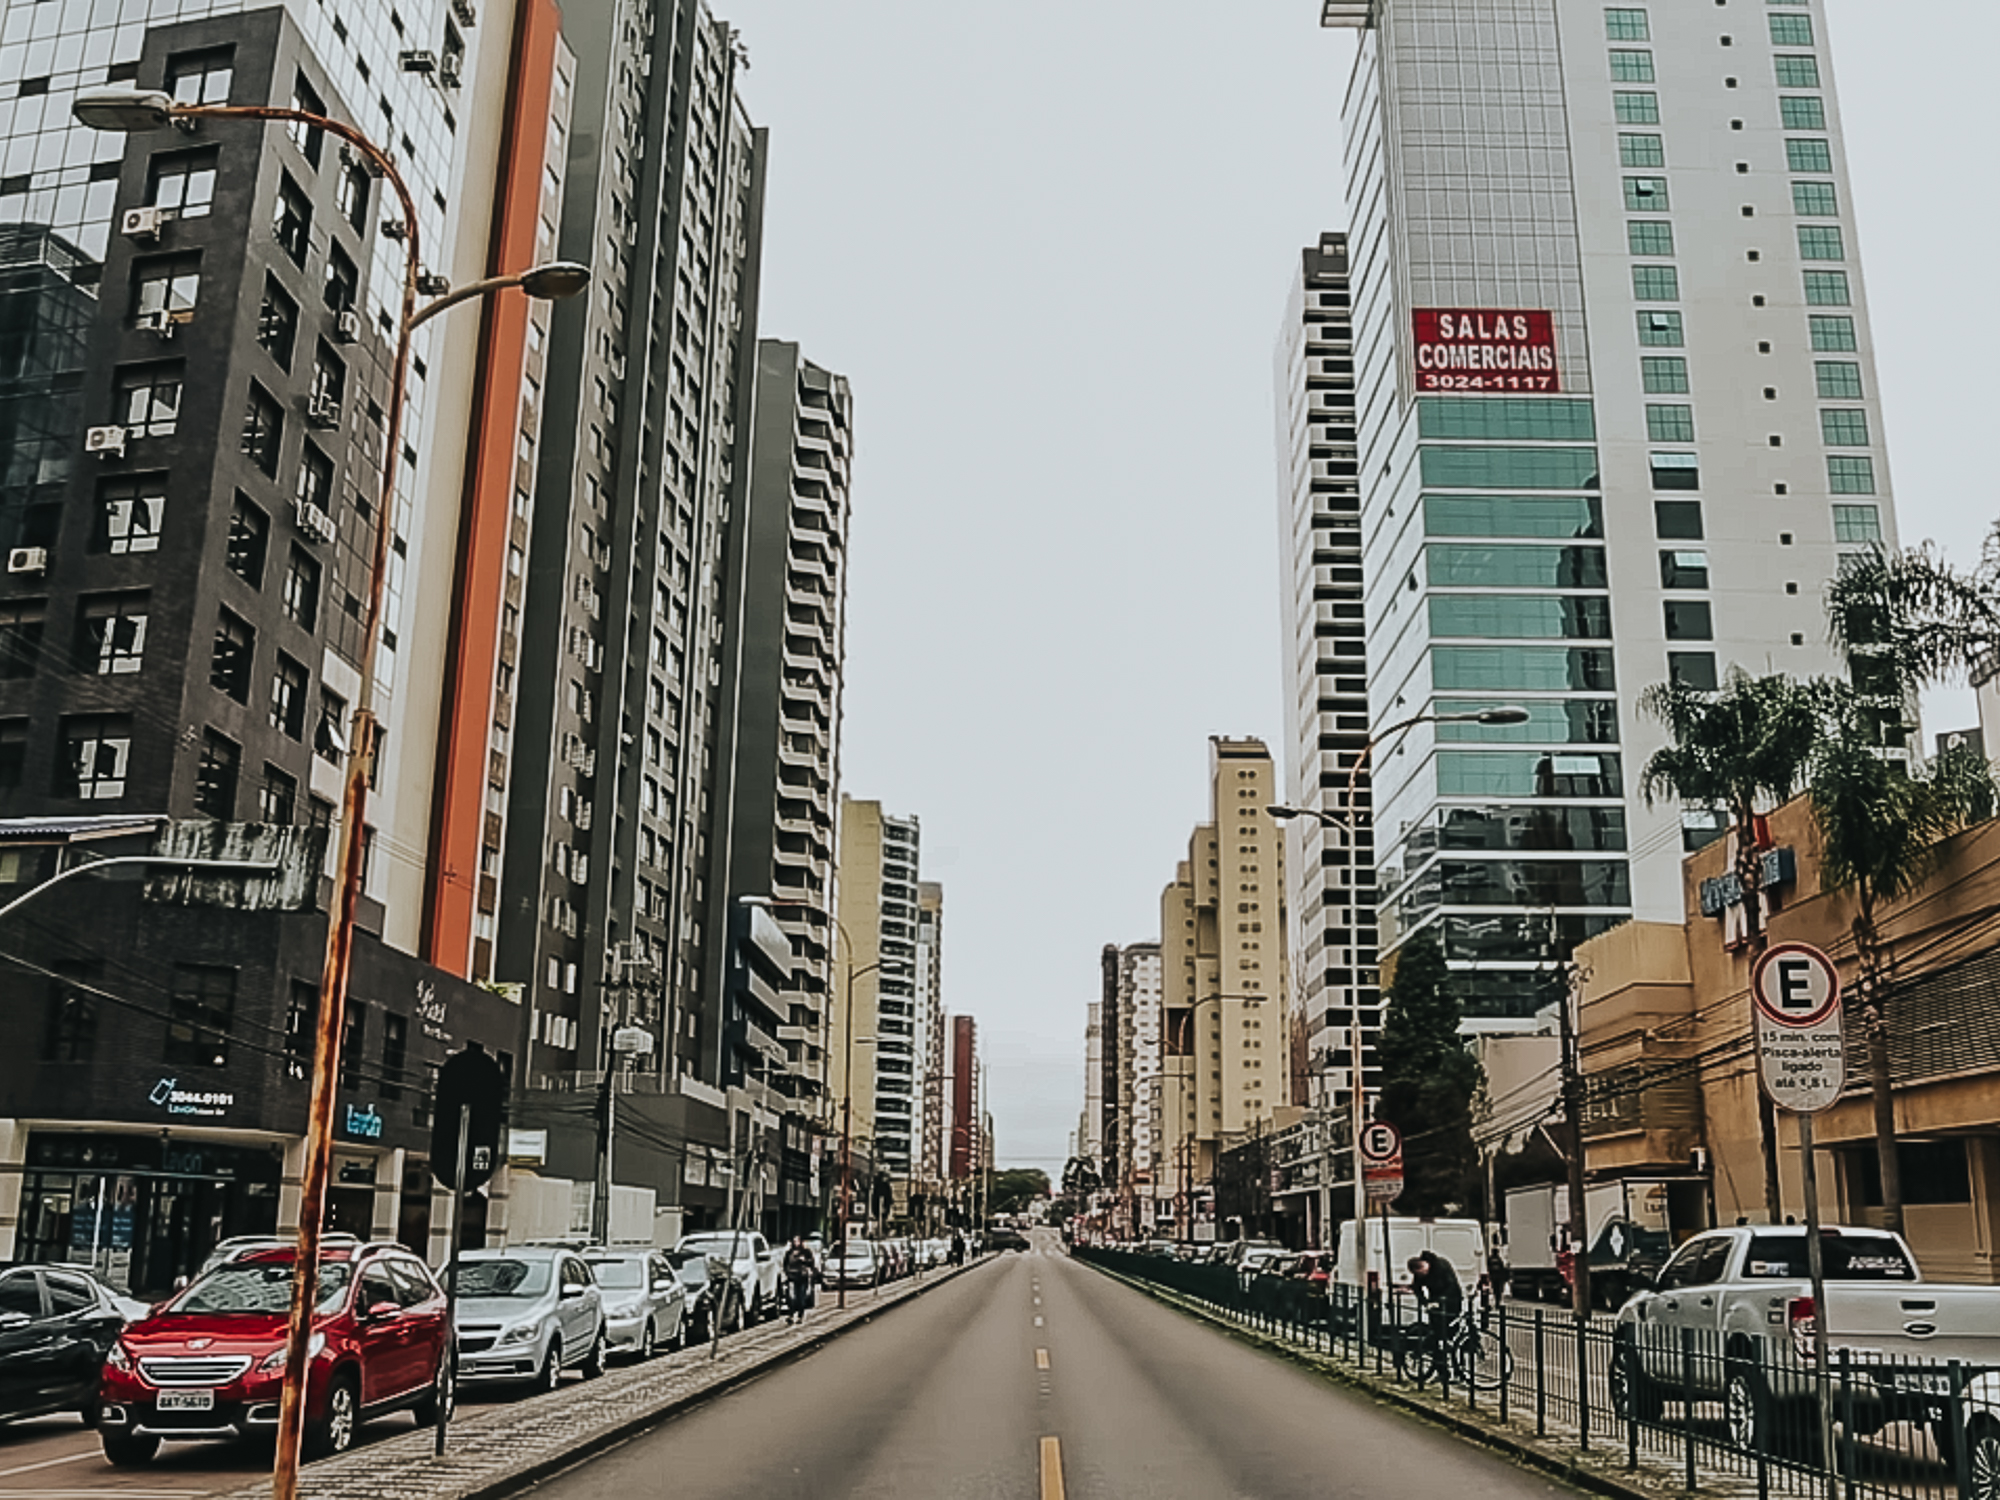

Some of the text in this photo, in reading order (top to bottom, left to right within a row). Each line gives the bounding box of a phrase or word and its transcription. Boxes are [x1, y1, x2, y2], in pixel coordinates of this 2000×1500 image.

[1440, 313, 1528, 340] SALAS
[1418, 343, 1552, 370] COMERCIAIS
[1425, 374, 1551, 389] 3024-1117
[1778, 960, 1813, 1008] E
[1762, 1031, 1841, 1042] 15 min. com
[1761, 1047, 1841, 1058] Pisca-alerta
[1782, 1061, 1822, 1074] ligado
[1775, 1077, 1796, 1088] até
[1372, 1129, 1389, 1152] E
